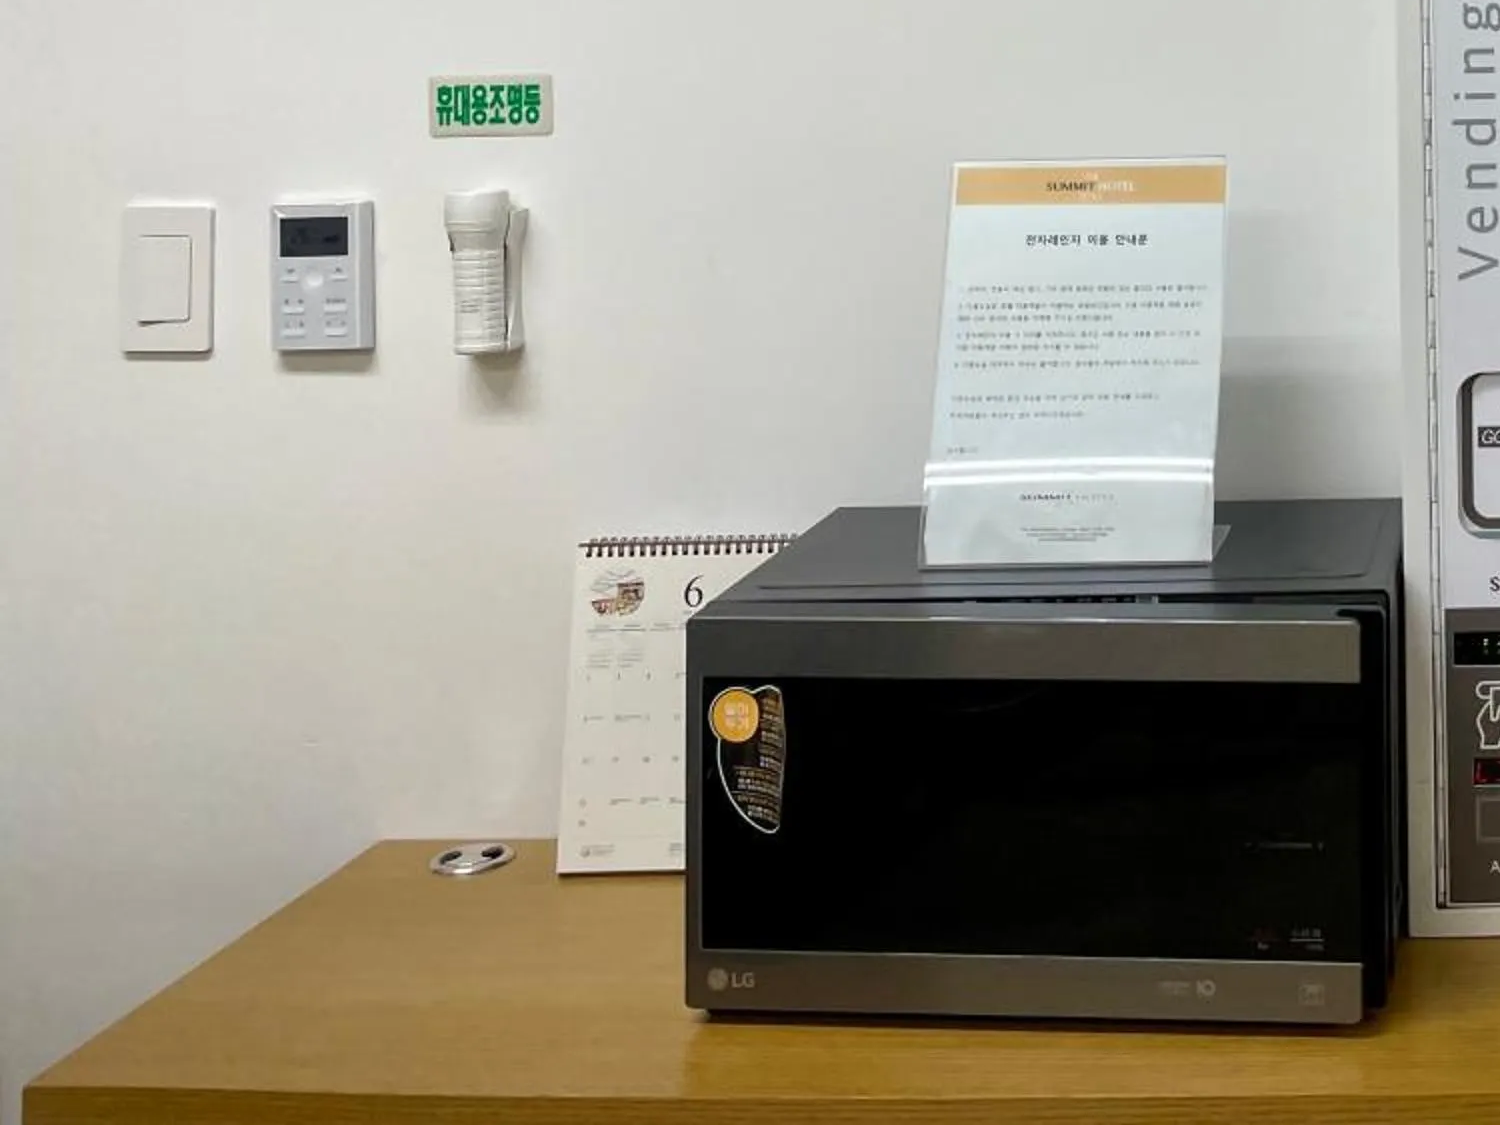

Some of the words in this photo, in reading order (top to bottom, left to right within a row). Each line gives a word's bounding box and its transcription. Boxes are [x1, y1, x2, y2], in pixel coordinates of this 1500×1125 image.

[436, 84, 541, 126] 휴대용조명등
[684, 576, 704, 608] 6
[731, 972, 755, 988] LG
